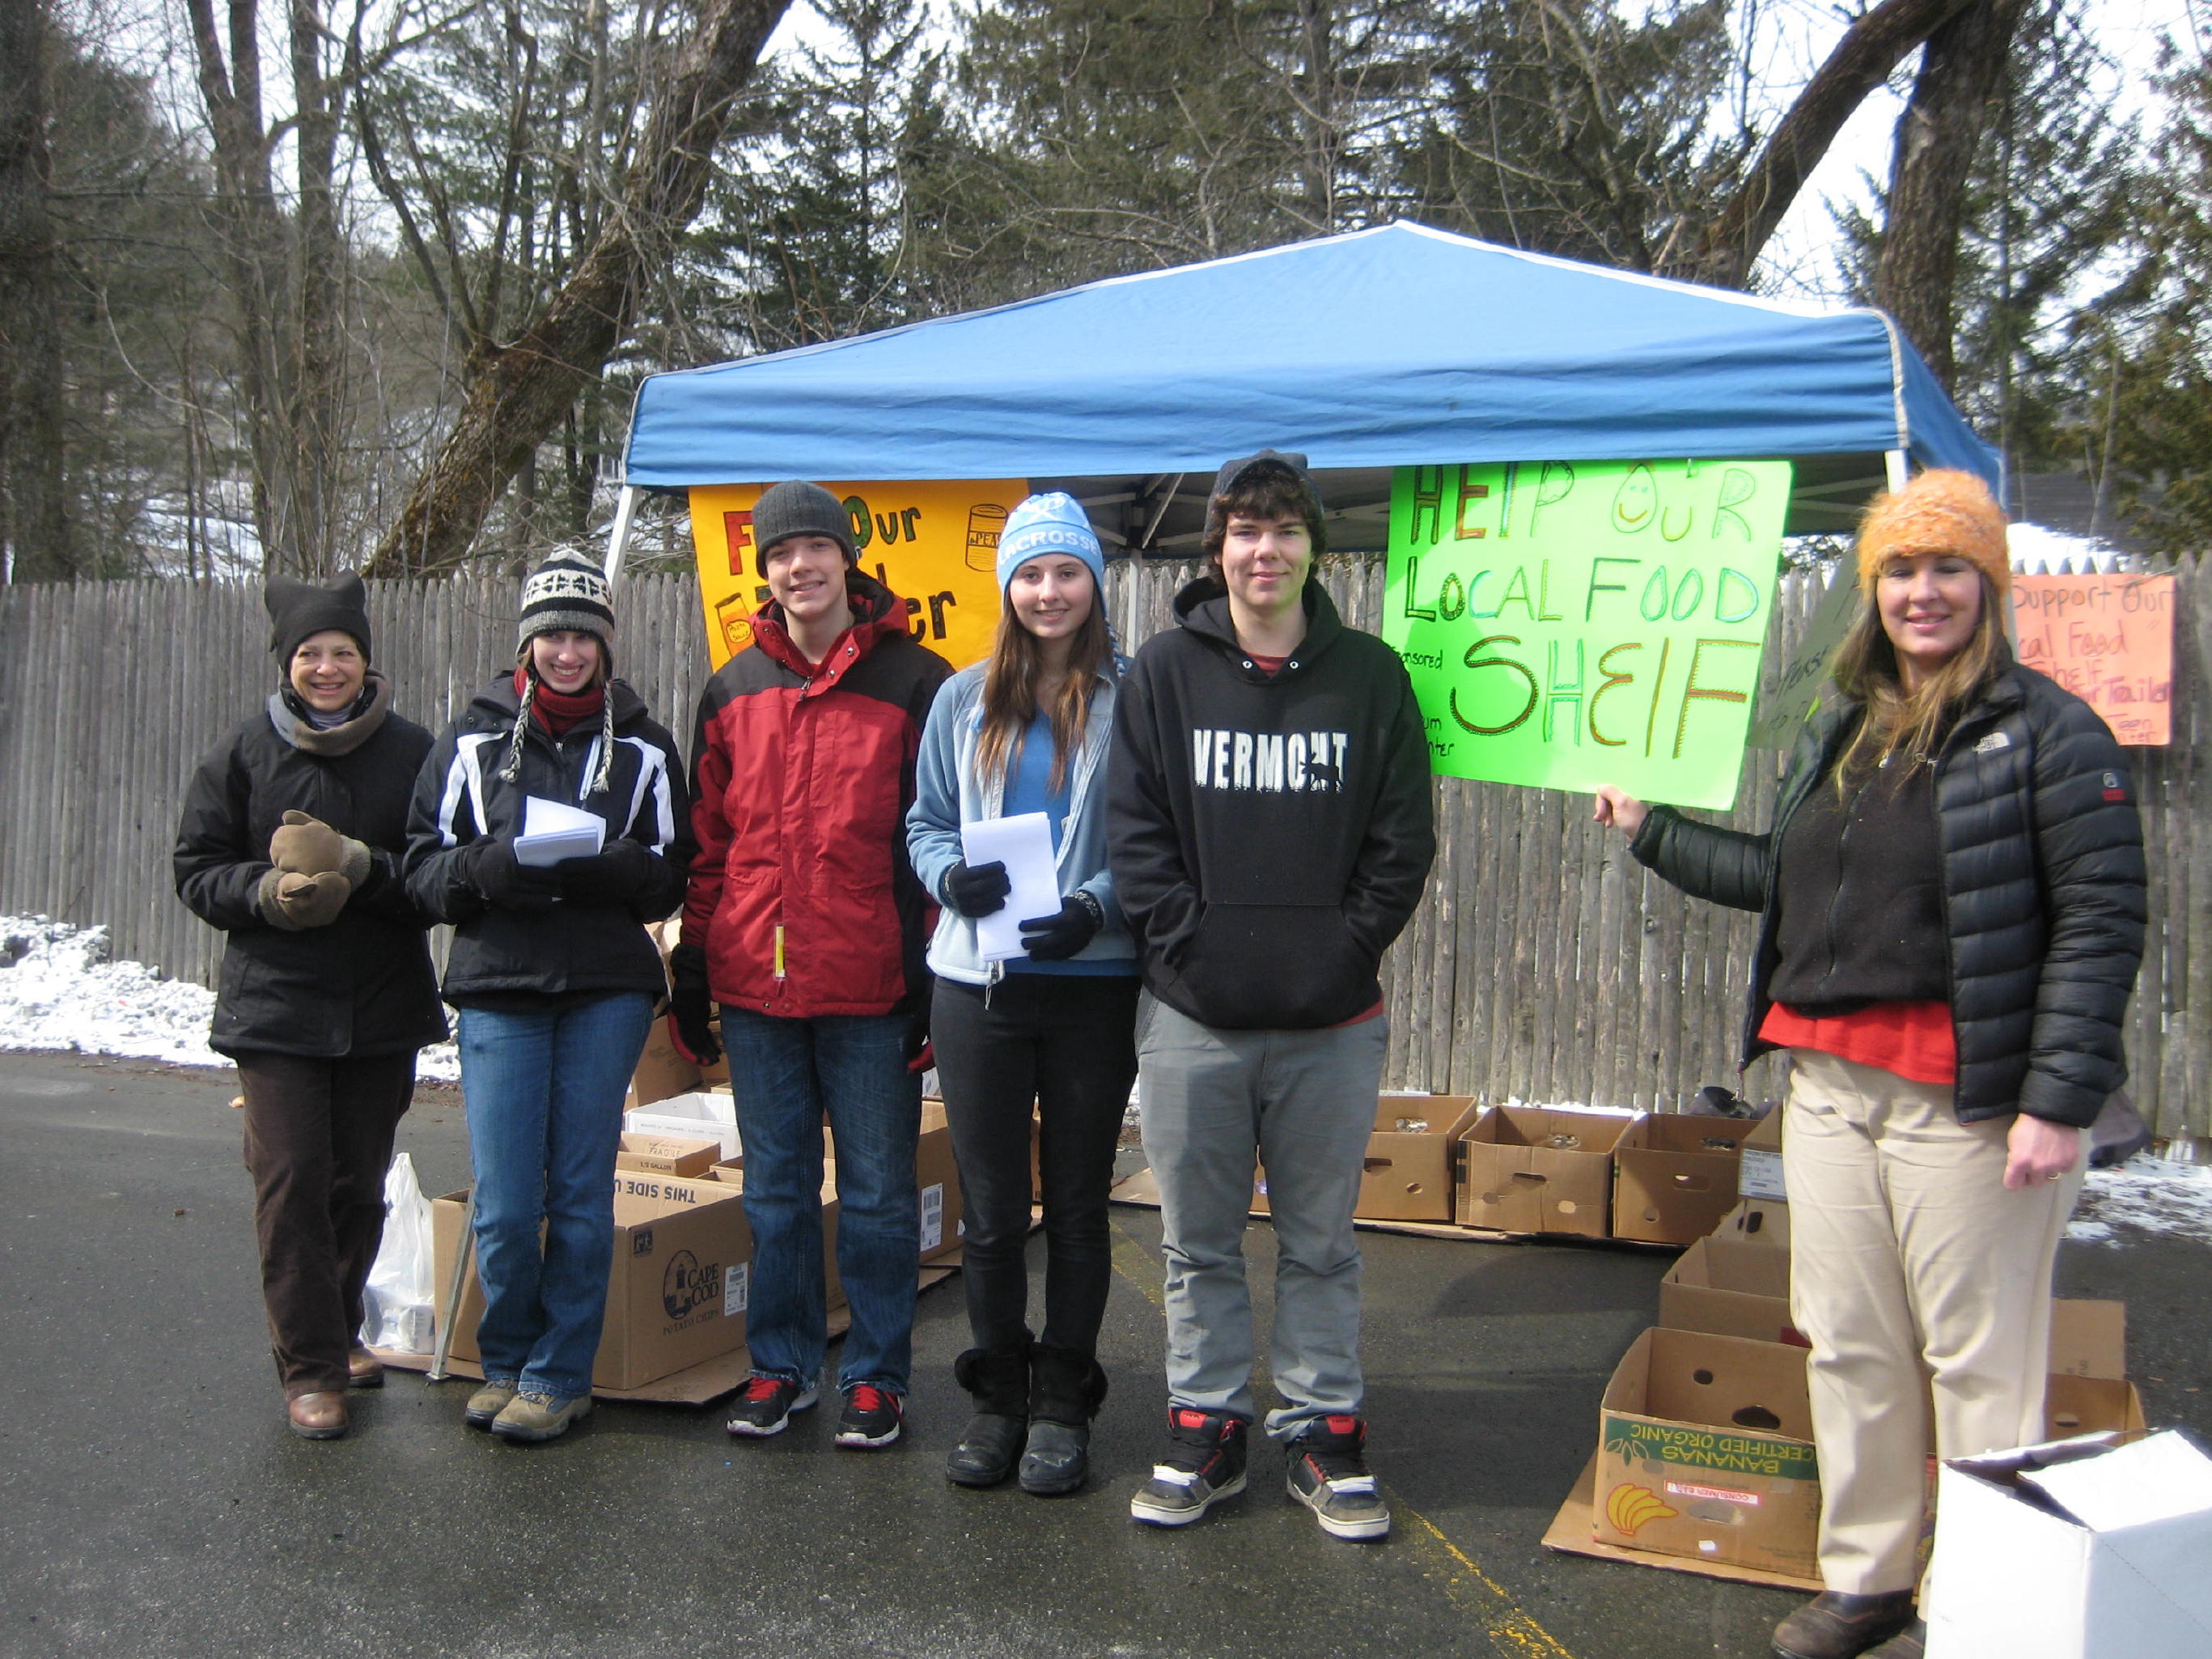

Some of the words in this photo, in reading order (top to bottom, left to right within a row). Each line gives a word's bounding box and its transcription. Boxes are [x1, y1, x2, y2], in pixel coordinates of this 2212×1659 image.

[1612, 463, 1758, 541] OUR
[841, 495, 922, 549] Our
[976, 532, 1001, 546] PEA
[1405, 556, 1563, 622] LOCAL
[1586, 557, 1760, 623] FOOD
[2122, 581, 2175, 613] Our
[2018, 624, 2053, 660] cal
[2068, 618, 2129, 658] Food
[1193, 728, 1349, 793] VERMONT
[650, 1161, 672, 1171] GALLON
[626, 1181, 659, 1199] SIDE
[664, 1186, 697, 1204] THIS
[689, 1262, 719, 1289] CAPE
[692, 1281, 719, 1306] COD
[663, 1320, 693, 1336] POTATO
[694, 1308, 719, 1324] CHIPS
[1629, 1424, 1714, 1449] ORGANIC
[1718, 1438, 1816, 1462] CERTIFIED
[1661, 1445, 1780, 1474] BANANAS
